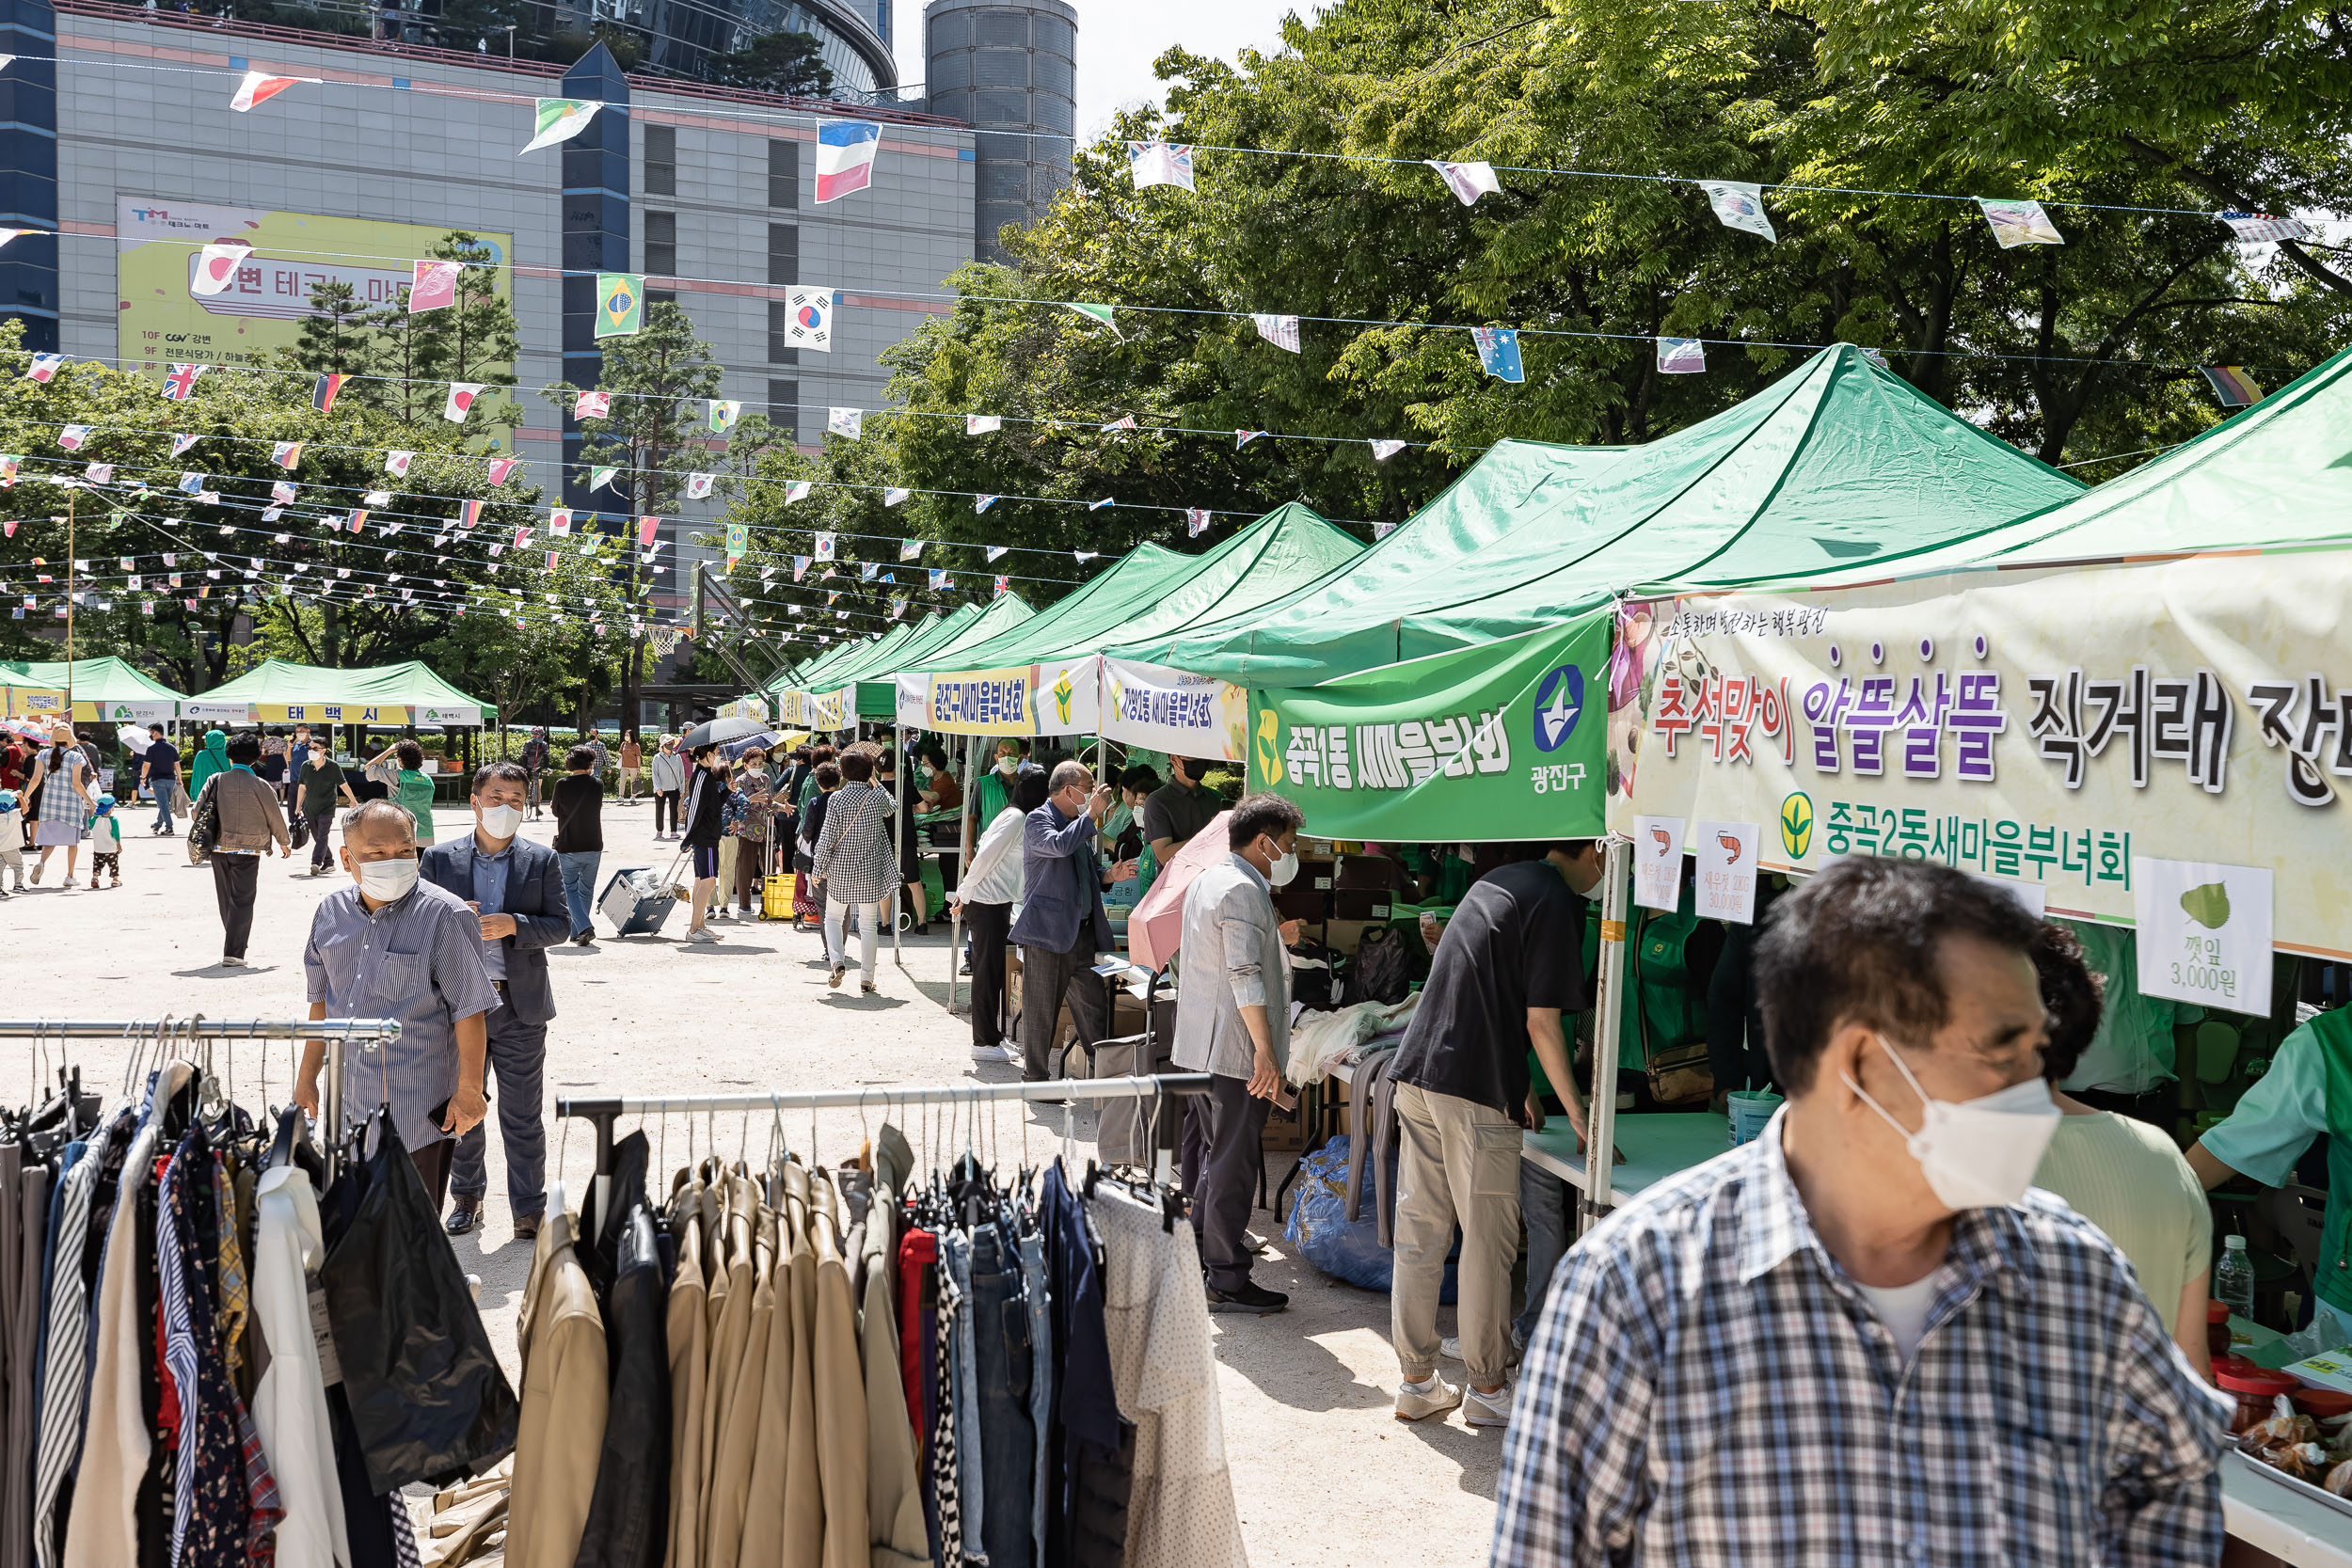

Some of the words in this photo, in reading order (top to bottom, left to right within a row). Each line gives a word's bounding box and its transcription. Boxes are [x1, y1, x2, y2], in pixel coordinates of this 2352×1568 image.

[142, 330, 160, 340] 10F
[166, 333, 188, 342] CGV
[192, 334, 212, 345] 강변
[144, 346, 157, 355] 9F
[165, 347, 214, 360] 전문식당가
[1670, 610, 1717, 638] 소통하며
[1720, 610, 1769, 637] 발전하는
[1121, 688, 1151, 723] 자양2동
[1152, 691, 1214, 729] 새마을부녀회
[1654, 673, 1793, 764] 추석맞이
[1802, 643, 2005, 779] 알뜰살뜰
[2026, 667, 2231, 791] 직거래
[1285, 724, 1354, 790] 중곡1동
[1531, 763, 1587, 795] 광진구
[1703, 870, 1729, 893] 새우젓
[1732, 875, 1750, 893] 2KG
[2184, 935, 2221, 966] 깻잎
[2170, 961, 2236, 998] 3,000원
